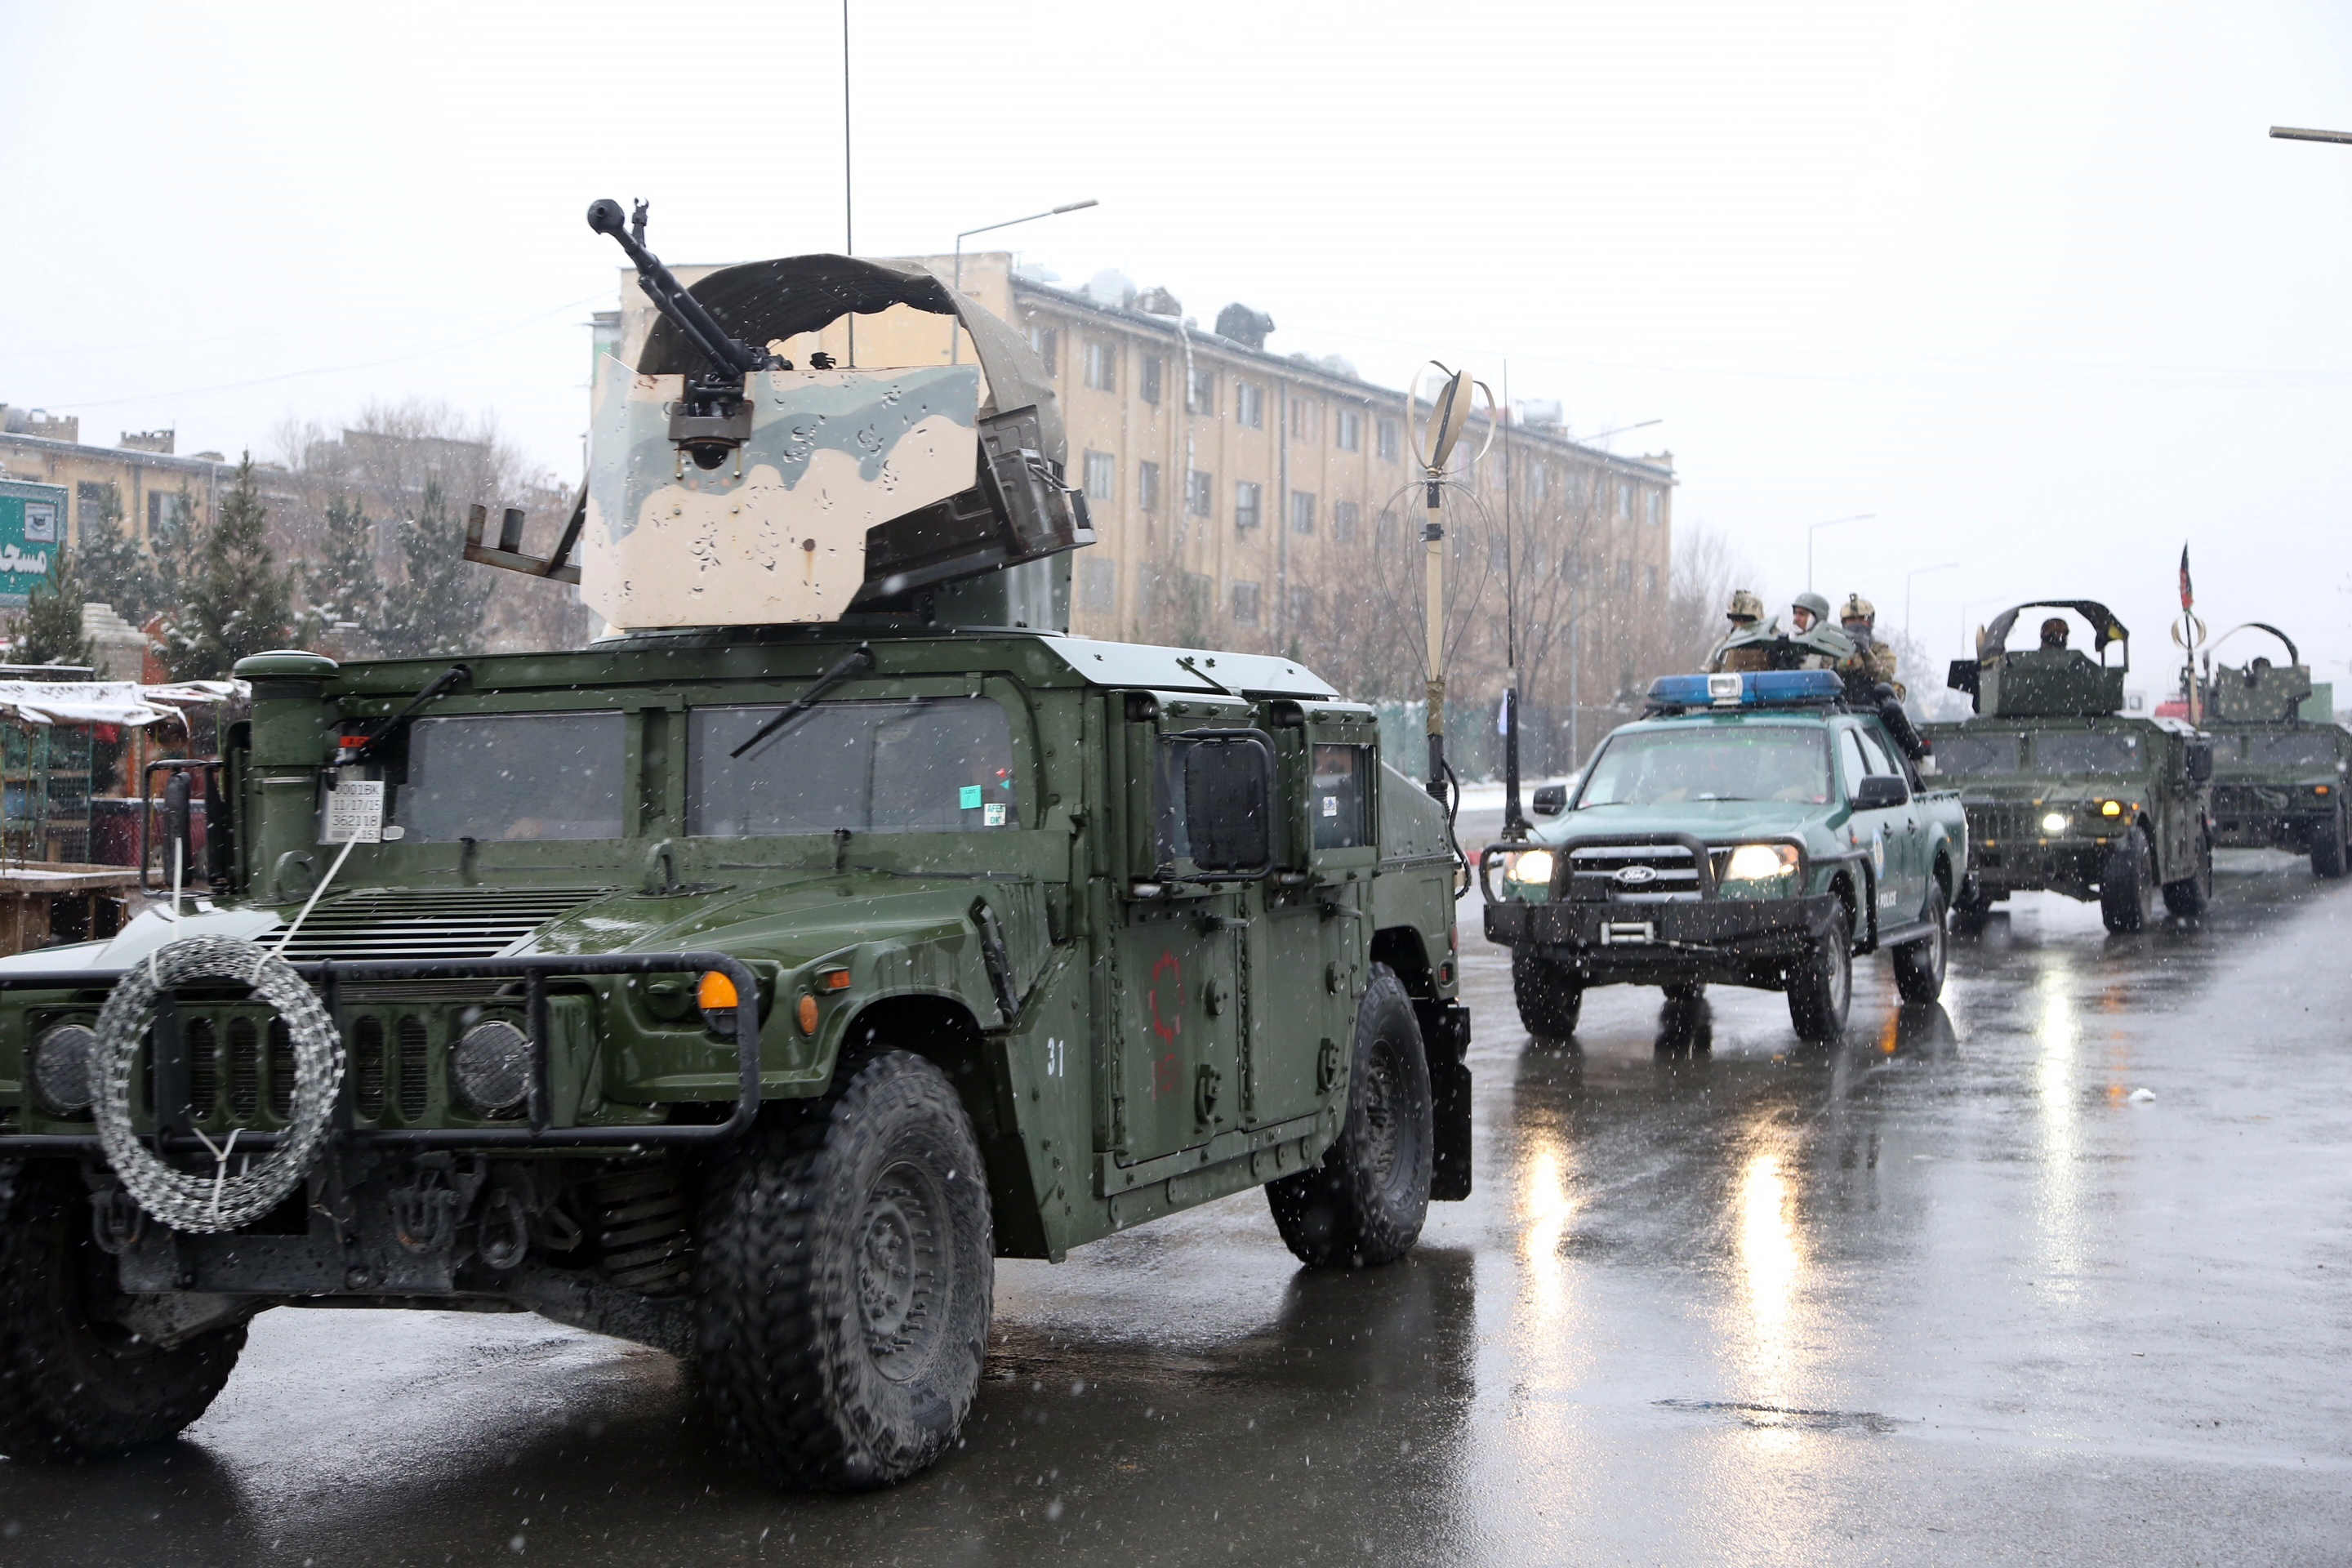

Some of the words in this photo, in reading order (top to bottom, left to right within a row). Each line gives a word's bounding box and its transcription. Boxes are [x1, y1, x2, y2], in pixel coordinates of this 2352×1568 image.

[333, 800, 381, 811] 11/17/15
[1624, 869, 1647, 880] Ford
[1879, 890, 1897, 909] POLICE
[1047, 1036, 1064, 1078] 31
